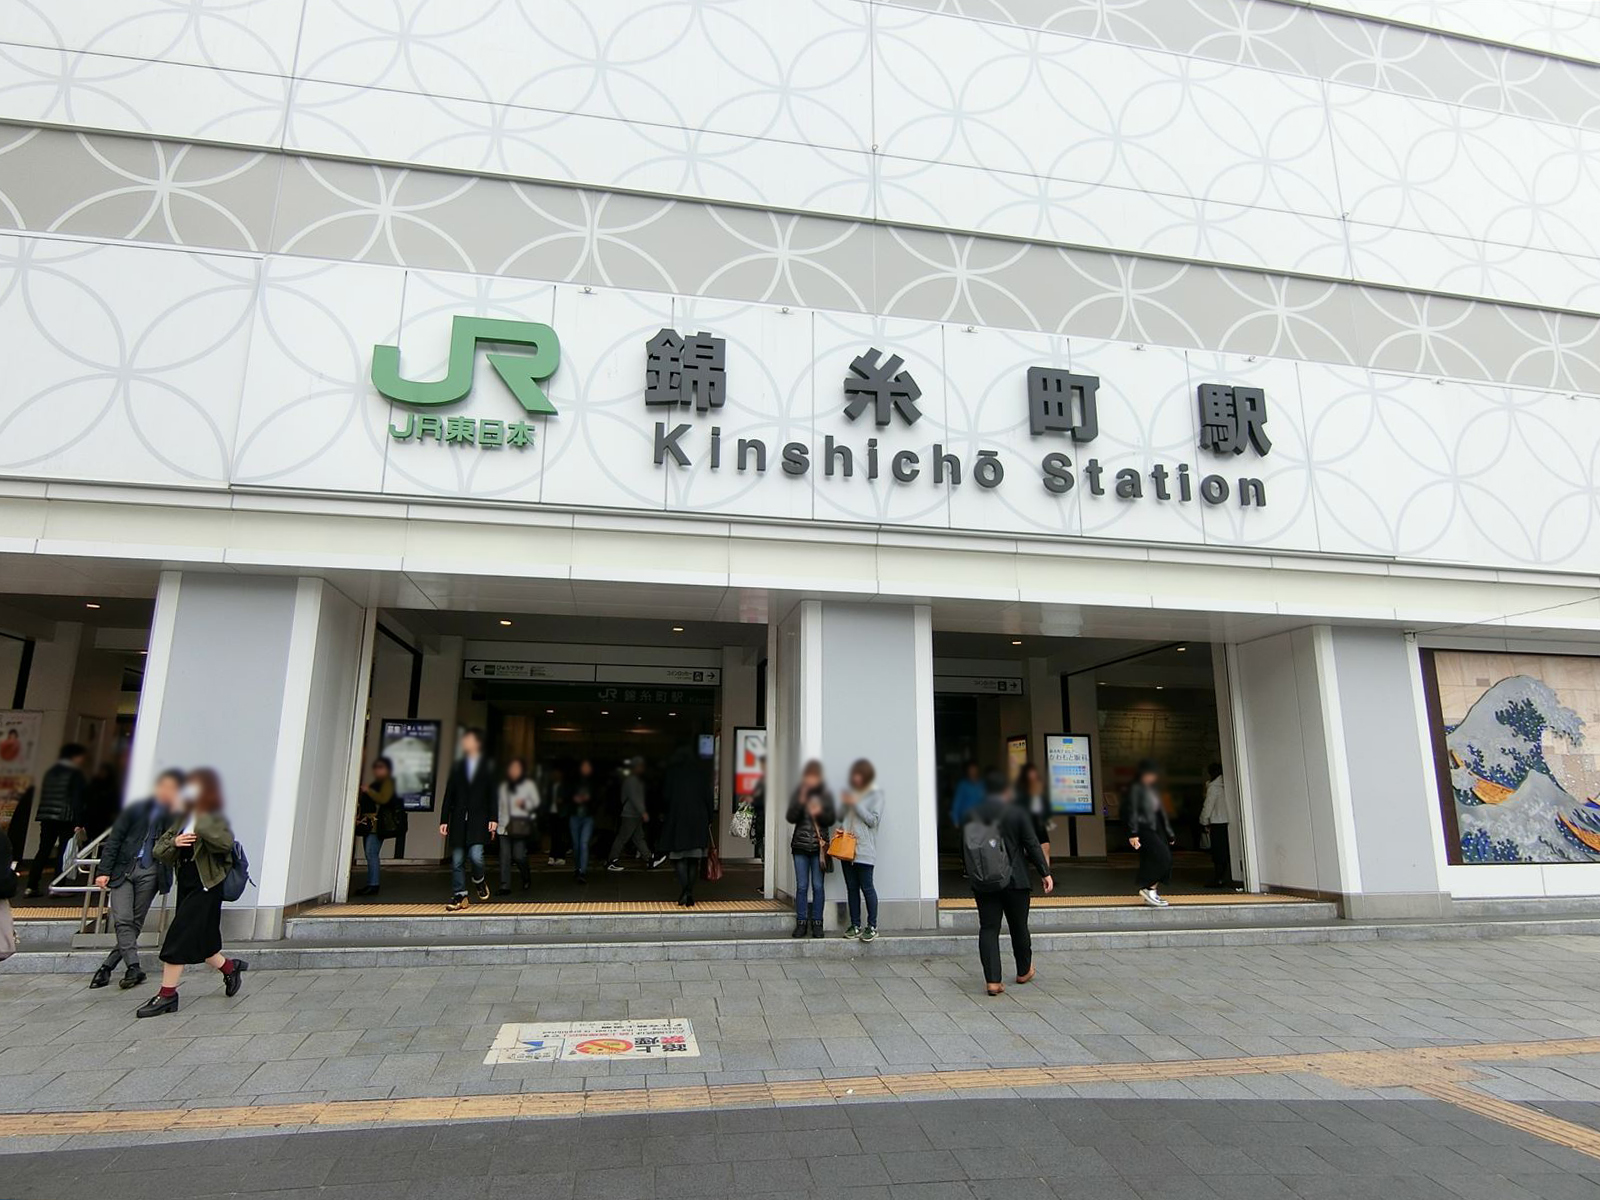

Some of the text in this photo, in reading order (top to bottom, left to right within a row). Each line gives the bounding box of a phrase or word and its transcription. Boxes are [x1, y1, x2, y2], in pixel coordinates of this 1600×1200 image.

[371, 315, 558, 416] JR
[645, 328, 1272, 457] 錦糸町駅
[388, 413, 536, 449] JR東日本
[653, 421, 1267, 508] Kinshichō Station
[598, 688, 618, 699] JR
